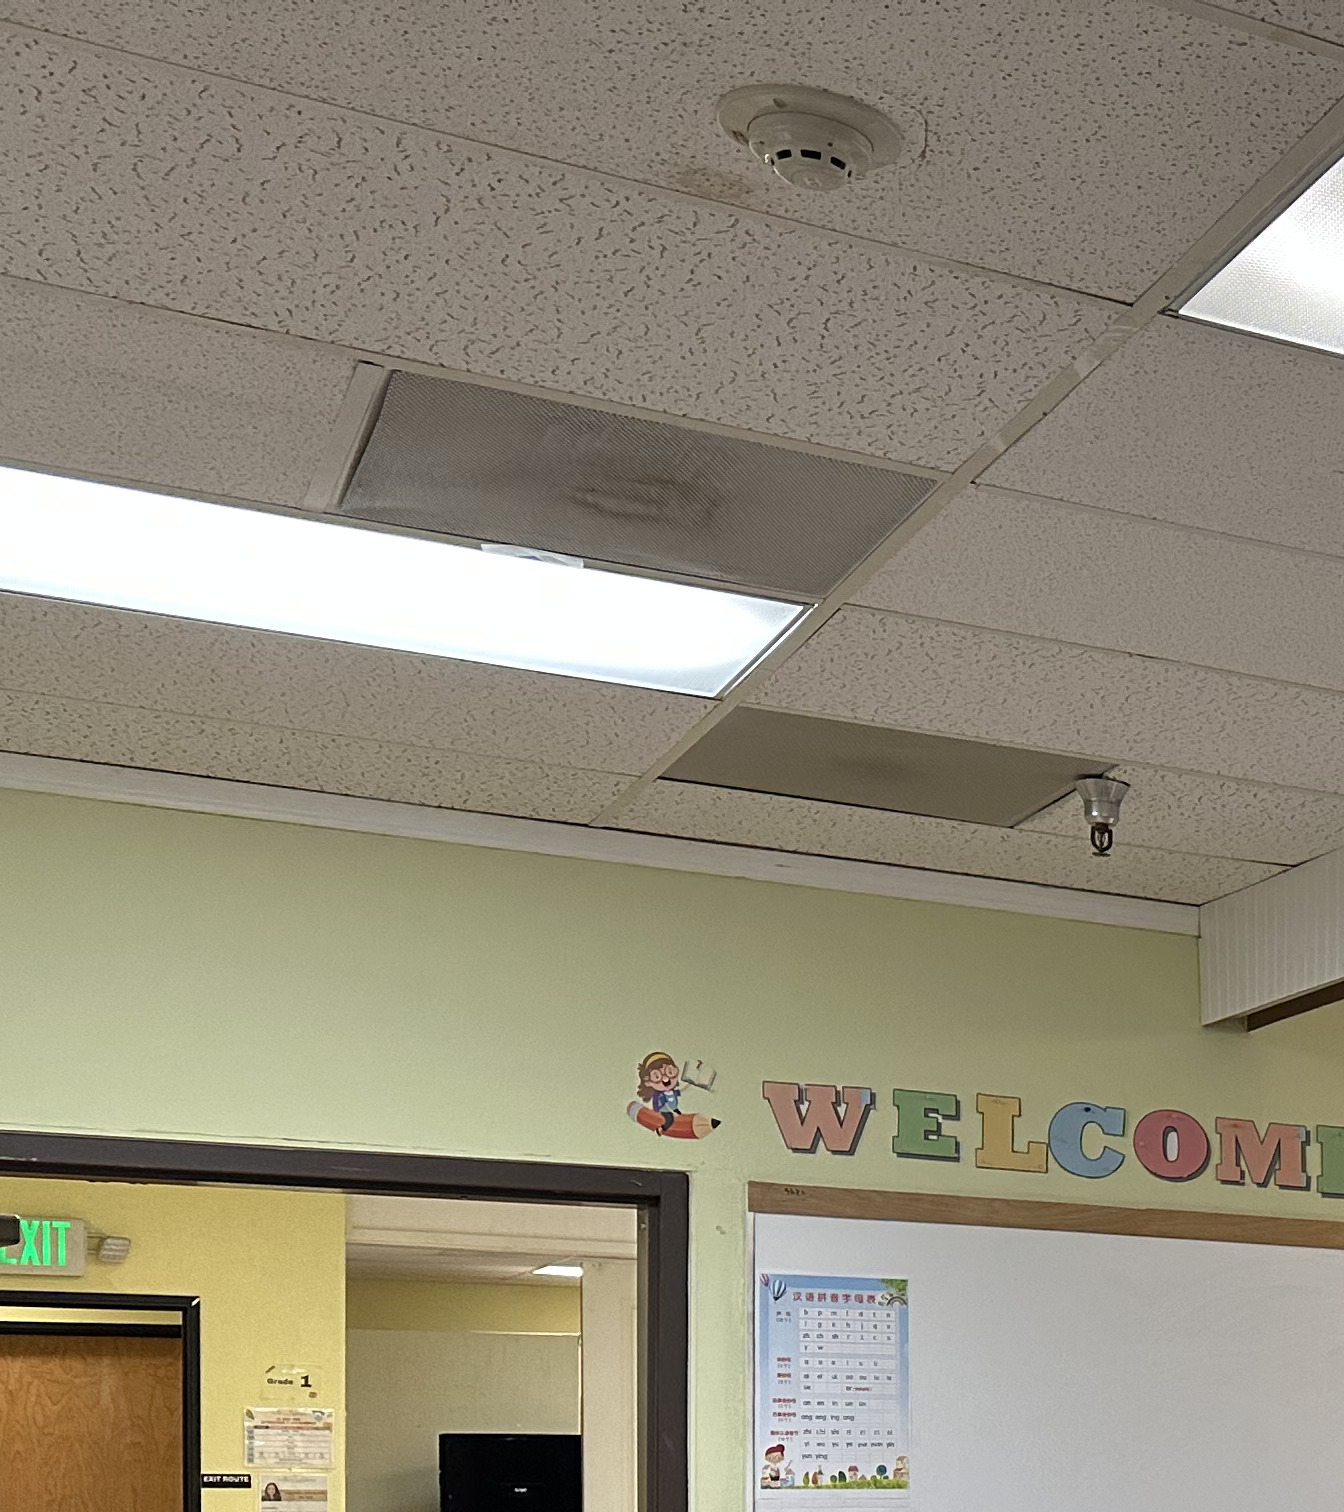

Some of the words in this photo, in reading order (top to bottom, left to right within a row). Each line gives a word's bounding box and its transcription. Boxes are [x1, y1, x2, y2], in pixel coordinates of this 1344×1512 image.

[266, 1377, 294, 1386] Grade
[300, 1375, 312, 1388] 1
[203, 1475, 221, 1483] EXIT
[222, 1475, 250, 1483] ROUTE
